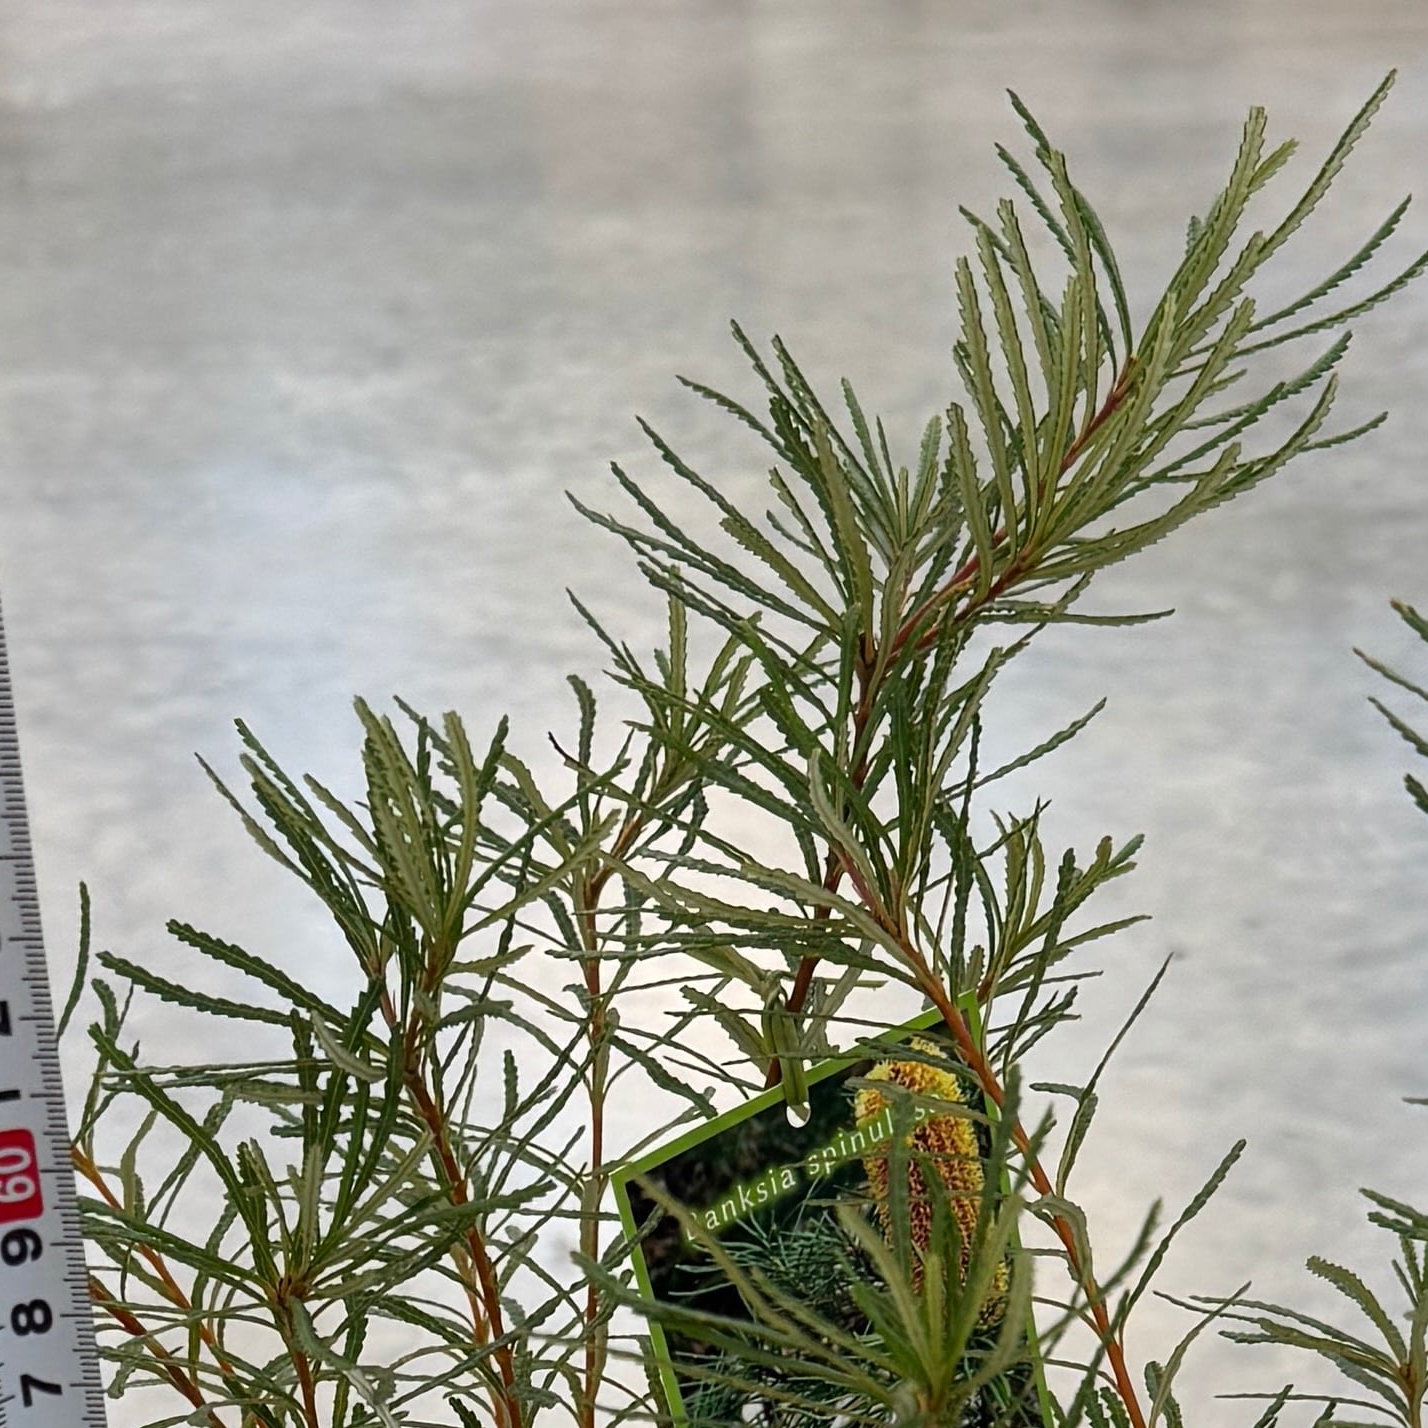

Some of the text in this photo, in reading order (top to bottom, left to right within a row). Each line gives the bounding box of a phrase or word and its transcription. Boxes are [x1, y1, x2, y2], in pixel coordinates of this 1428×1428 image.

[1, 1228, 42, 1266] 9
[11, 1299, 52, 1336] 8
[20, 1374, 62, 1407] 7
